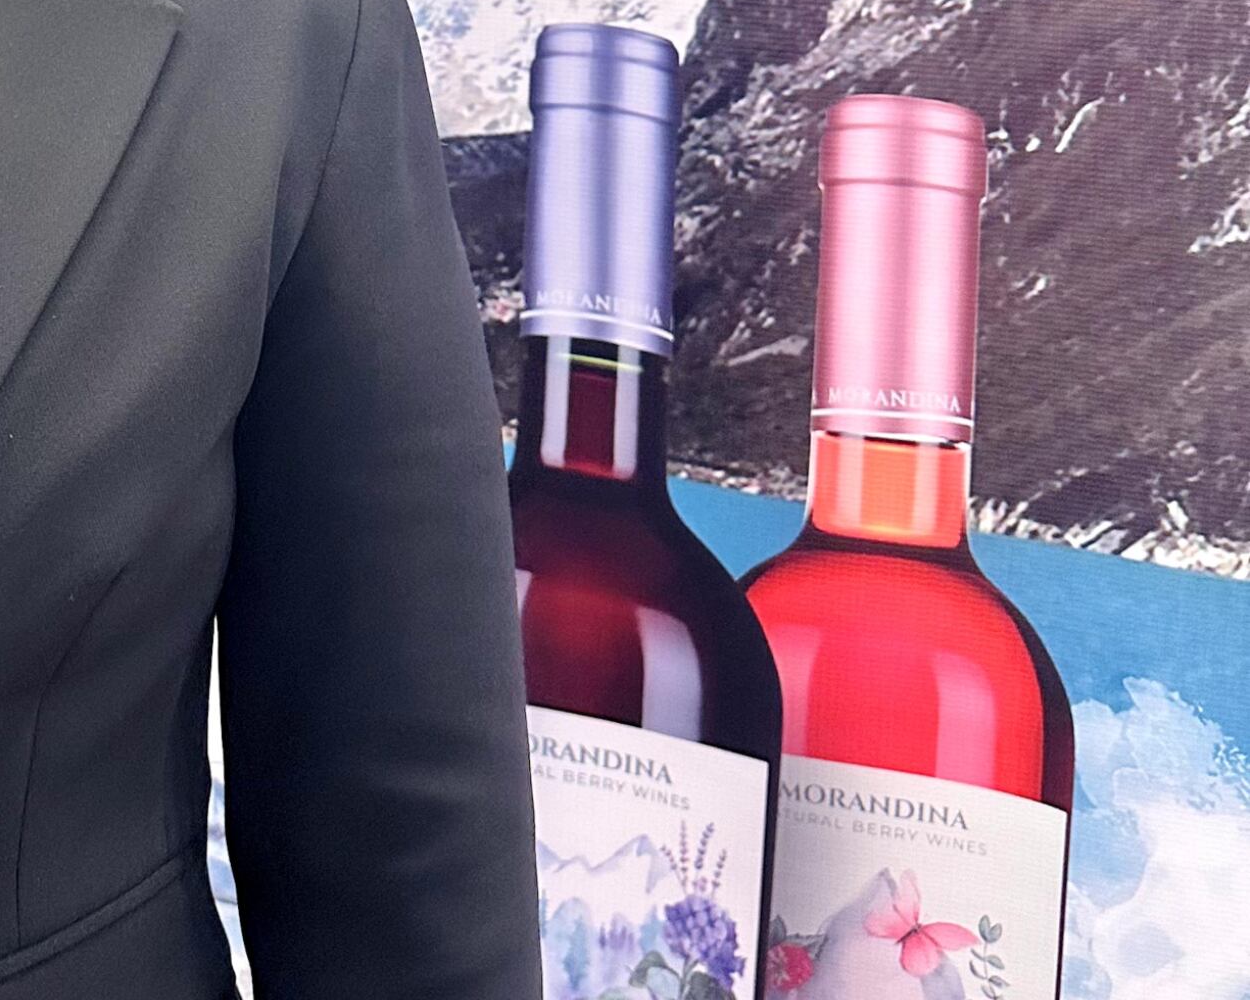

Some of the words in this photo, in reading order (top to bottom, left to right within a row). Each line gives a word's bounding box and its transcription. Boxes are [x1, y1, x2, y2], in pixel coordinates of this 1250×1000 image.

[828, 386, 961, 414] MORANDINA
[562, 768, 624, 793] BERRY
[632, 783, 691, 811] WINES
[779, 782, 969, 830] MORANDINA
[777, 806, 844, 829] TURAL
[852, 819, 918, 842] BERRY
[927, 831, 988, 856] WINES
